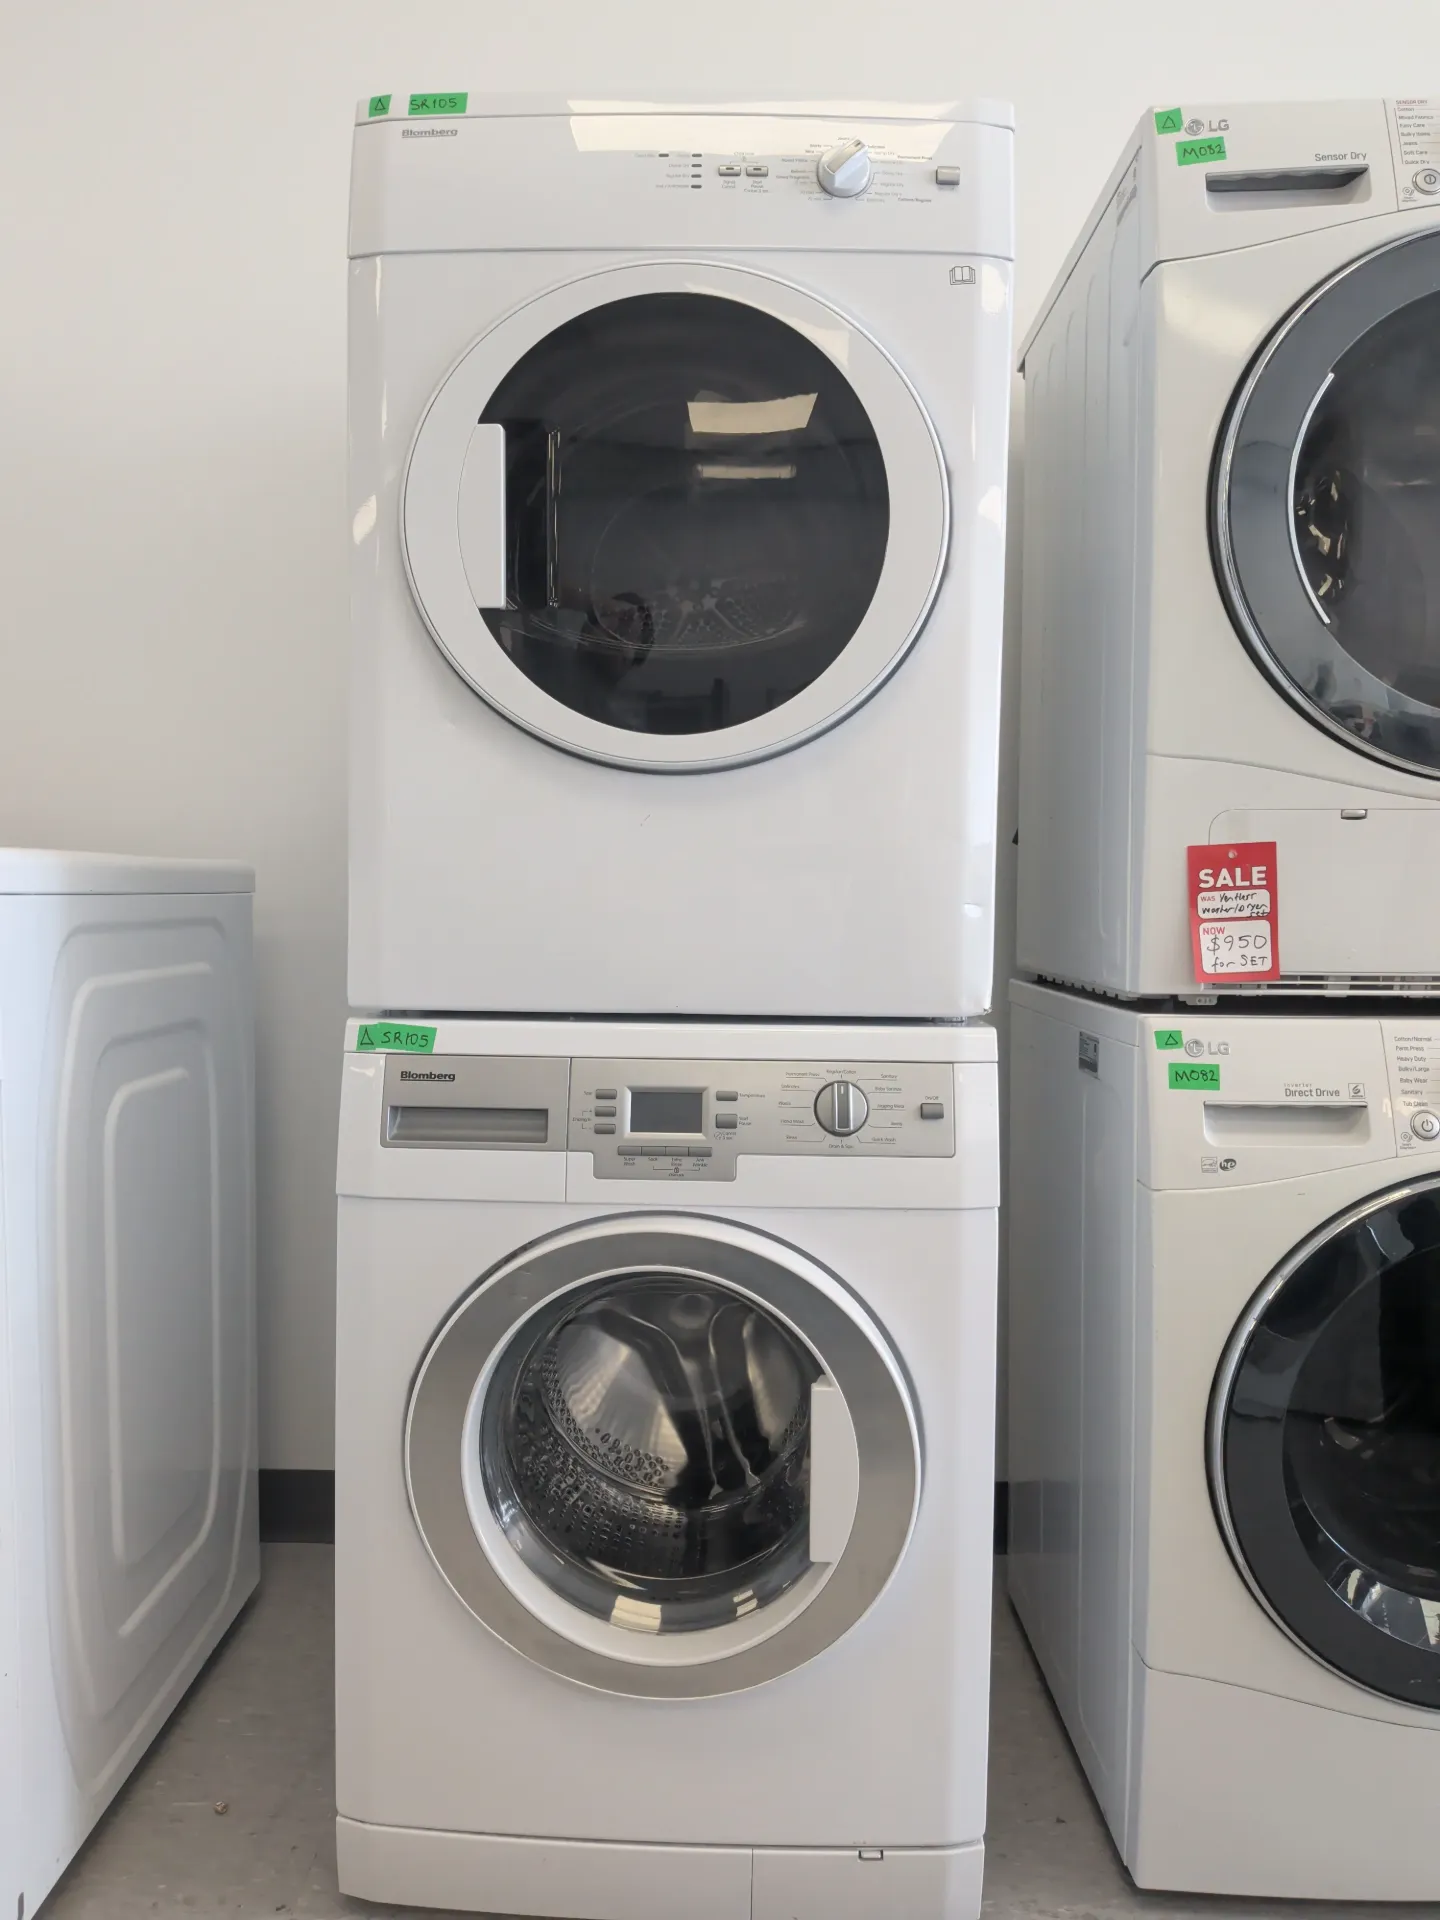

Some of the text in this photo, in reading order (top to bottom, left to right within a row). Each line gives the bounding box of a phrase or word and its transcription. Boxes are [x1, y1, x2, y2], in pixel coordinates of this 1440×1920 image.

[410, 98, 458, 111] SR105
[1208, 120, 1230, 132] LG
[401, 128, 458, 138] Blomberg
[1182, 144, 1226, 159] M082
[1314, 151, 1368, 163] Sensor Dry
[1198, 866, 1267, 888] SALE
[1202, 927, 1226, 935] NOW
[1206, 935, 1268, 956] $950
[1211, 954, 1268, 972] for SET
[381, 1031, 429, 1048] SR105
[1208, 1042, 1230, 1055] LG
[400, 1071, 456, 1082] Blomberg
[1175, 1070, 1218, 1082] M082
[1285, 1088, 1340, 1097] Direct Drive
[1220, 1159, 1236, 1171] he
